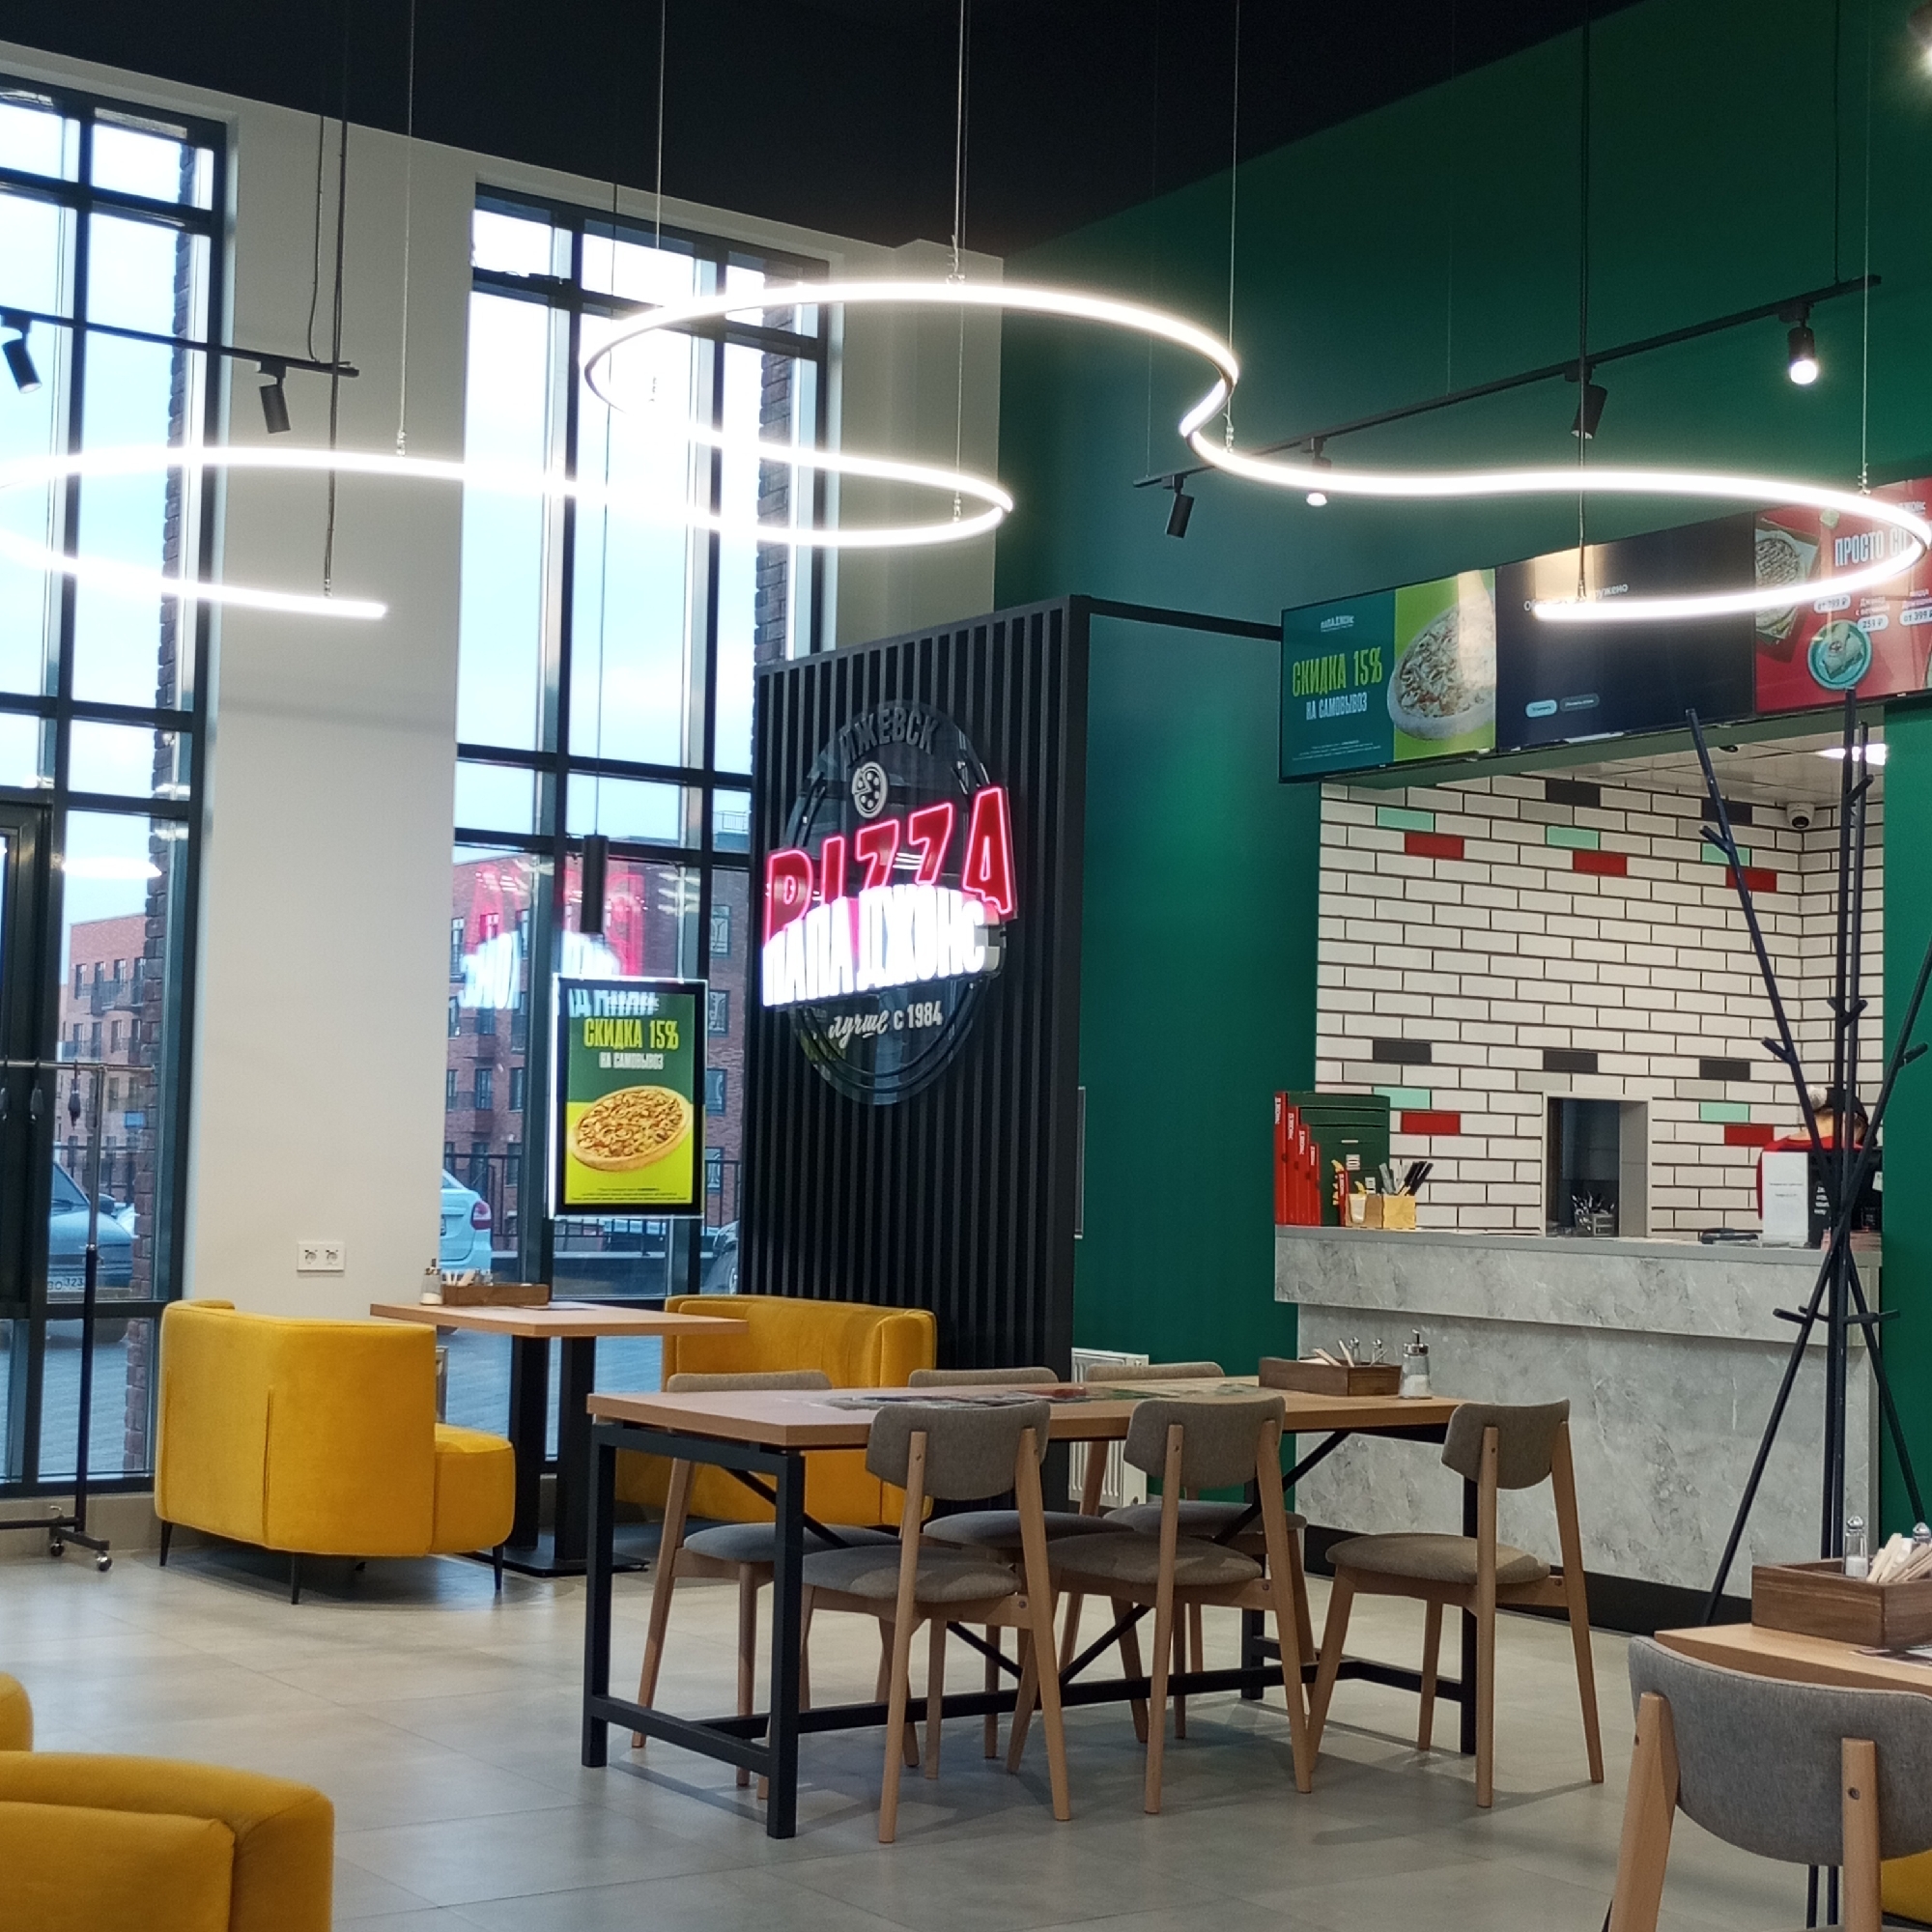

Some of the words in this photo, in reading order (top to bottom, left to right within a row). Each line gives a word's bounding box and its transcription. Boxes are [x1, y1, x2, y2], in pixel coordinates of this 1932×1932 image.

[1834, 530, 1885, 568] ПРОСТО
[1293, 653, 1347, 697] СКИДКА
[1353, 646, 1382, 687] 15%
[1306, 700, 1317, 721] НА
[1319, 692, 1367, 719] САМОВЫВОЗ
[838, 706, 939, 768] ИЖЕВСК
[763, 785, 1017, 952] PIZZA
[762, 895, 854, 1007] ПАПА
[856, 883, 989, 992] ДЖОНС
[583, 1017, 643, 1050] СКИДКА
[650, 1020, 679, 1050] 15%
[907, 1000, 943, 1029] 1984
